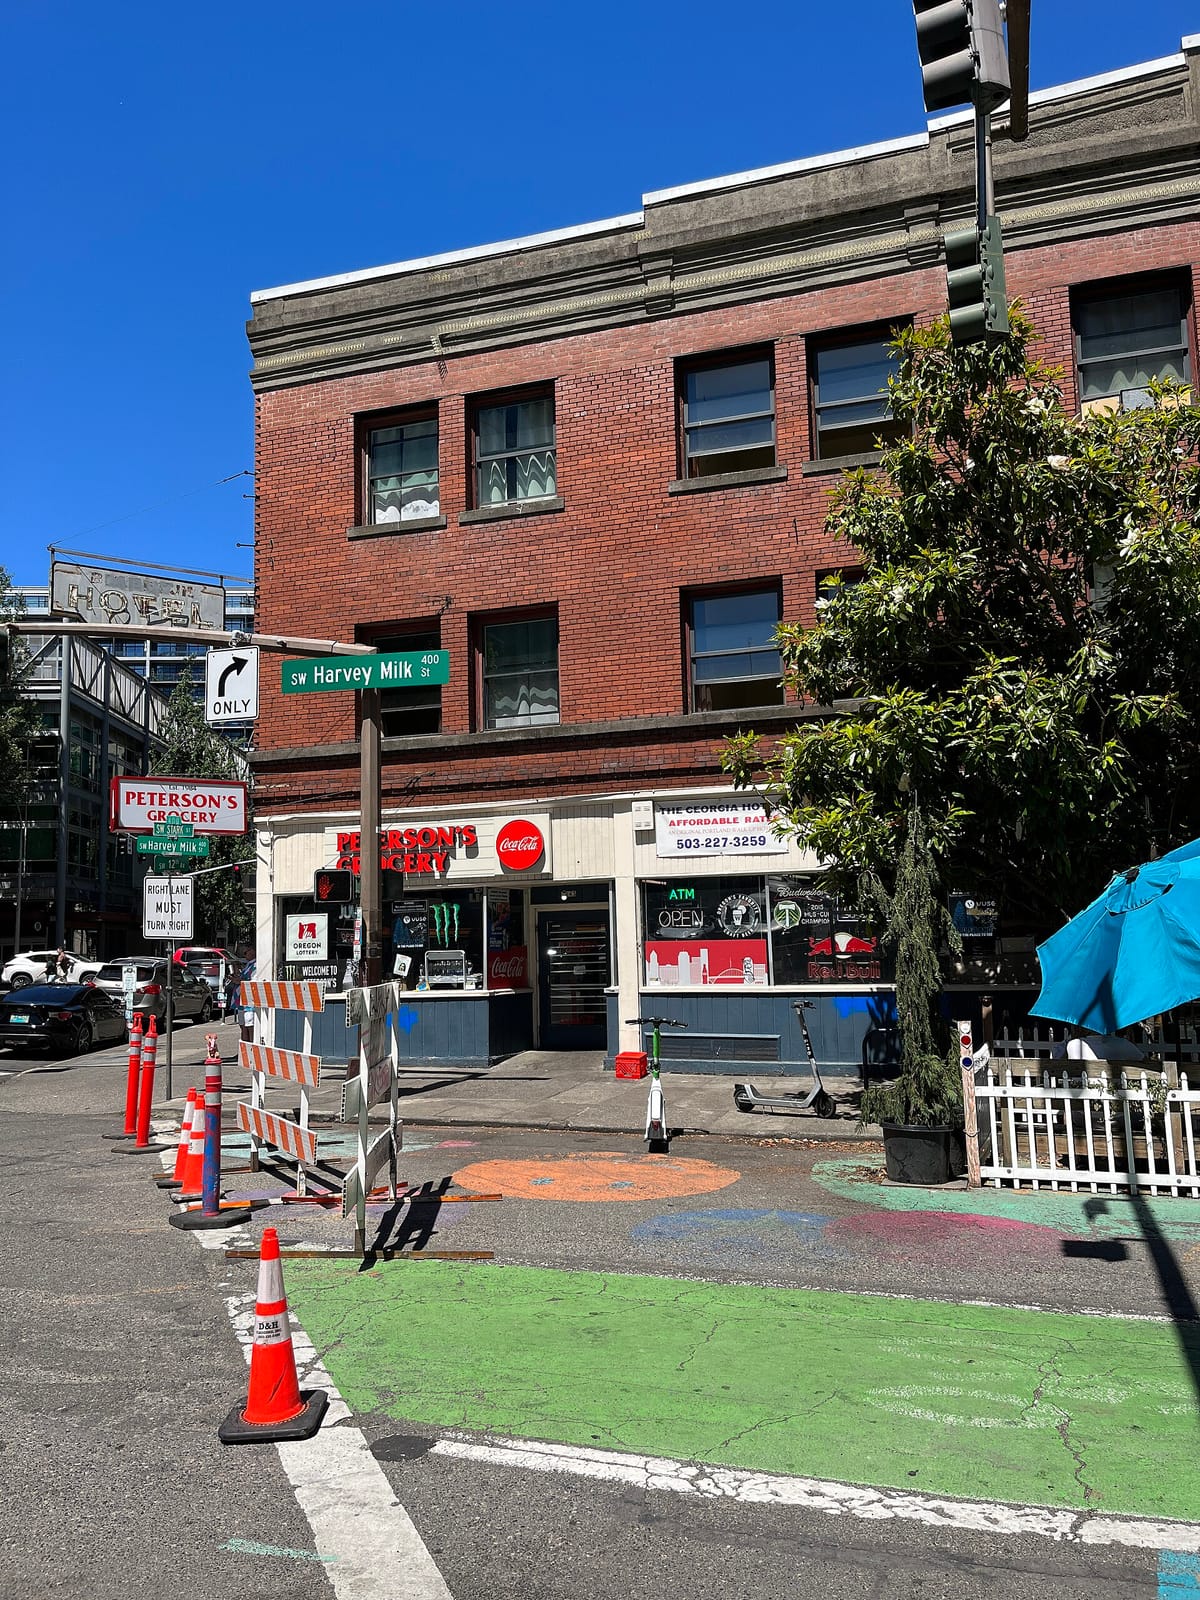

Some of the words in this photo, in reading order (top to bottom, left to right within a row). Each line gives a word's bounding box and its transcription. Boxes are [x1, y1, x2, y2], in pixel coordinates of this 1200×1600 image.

[421, 654, 440, 665] 400
[291, 671, 307, 686] SW
[313, 664, 373, 685] Harvey
[380, 660, 413, 680] Milk
[421, 666, 431, 678] St
[213, 699, 251, 715] ONLY
[125, 791, 238, 809] PETERSON'S
[659, 806, 683, 816] THE
[685, 803, 739, 815] GEORGIA
[742, 802, 767, 812] HOT
[668, 816, 739, 827] AFFORDABLE
[156, 824, 165, 834] SW
[167, 824, 184, 835] STARK
[336, 825, 477, 852] PEERSON'S
[676, 835, 767, 849] 503-227-3259
[140, 842, 147, 850] SW
[148, 840, 177, 853] Harvey
[180, 842, 197, 853] Milk
[147, 884, 169, 894] RIGHT
[170, 885, 190, 895] LANE
[669, 888, 695, 900] ATM
[155, 902, 182, 914] MUST
[147, 920, 166, 930] TURN
[168, 920, 190, 930] RIGHT
[658, 910, 704, 928] OPEN
[293, 942, 322, 950] OREGON
[302, 965, 330, 977] WELCOME
[330, 965, 338, 976] TO
[808, 960, 843, 979] Red
[846, 960, 881, 979] Bull
[258, 1321, 279, 1330] D&H
